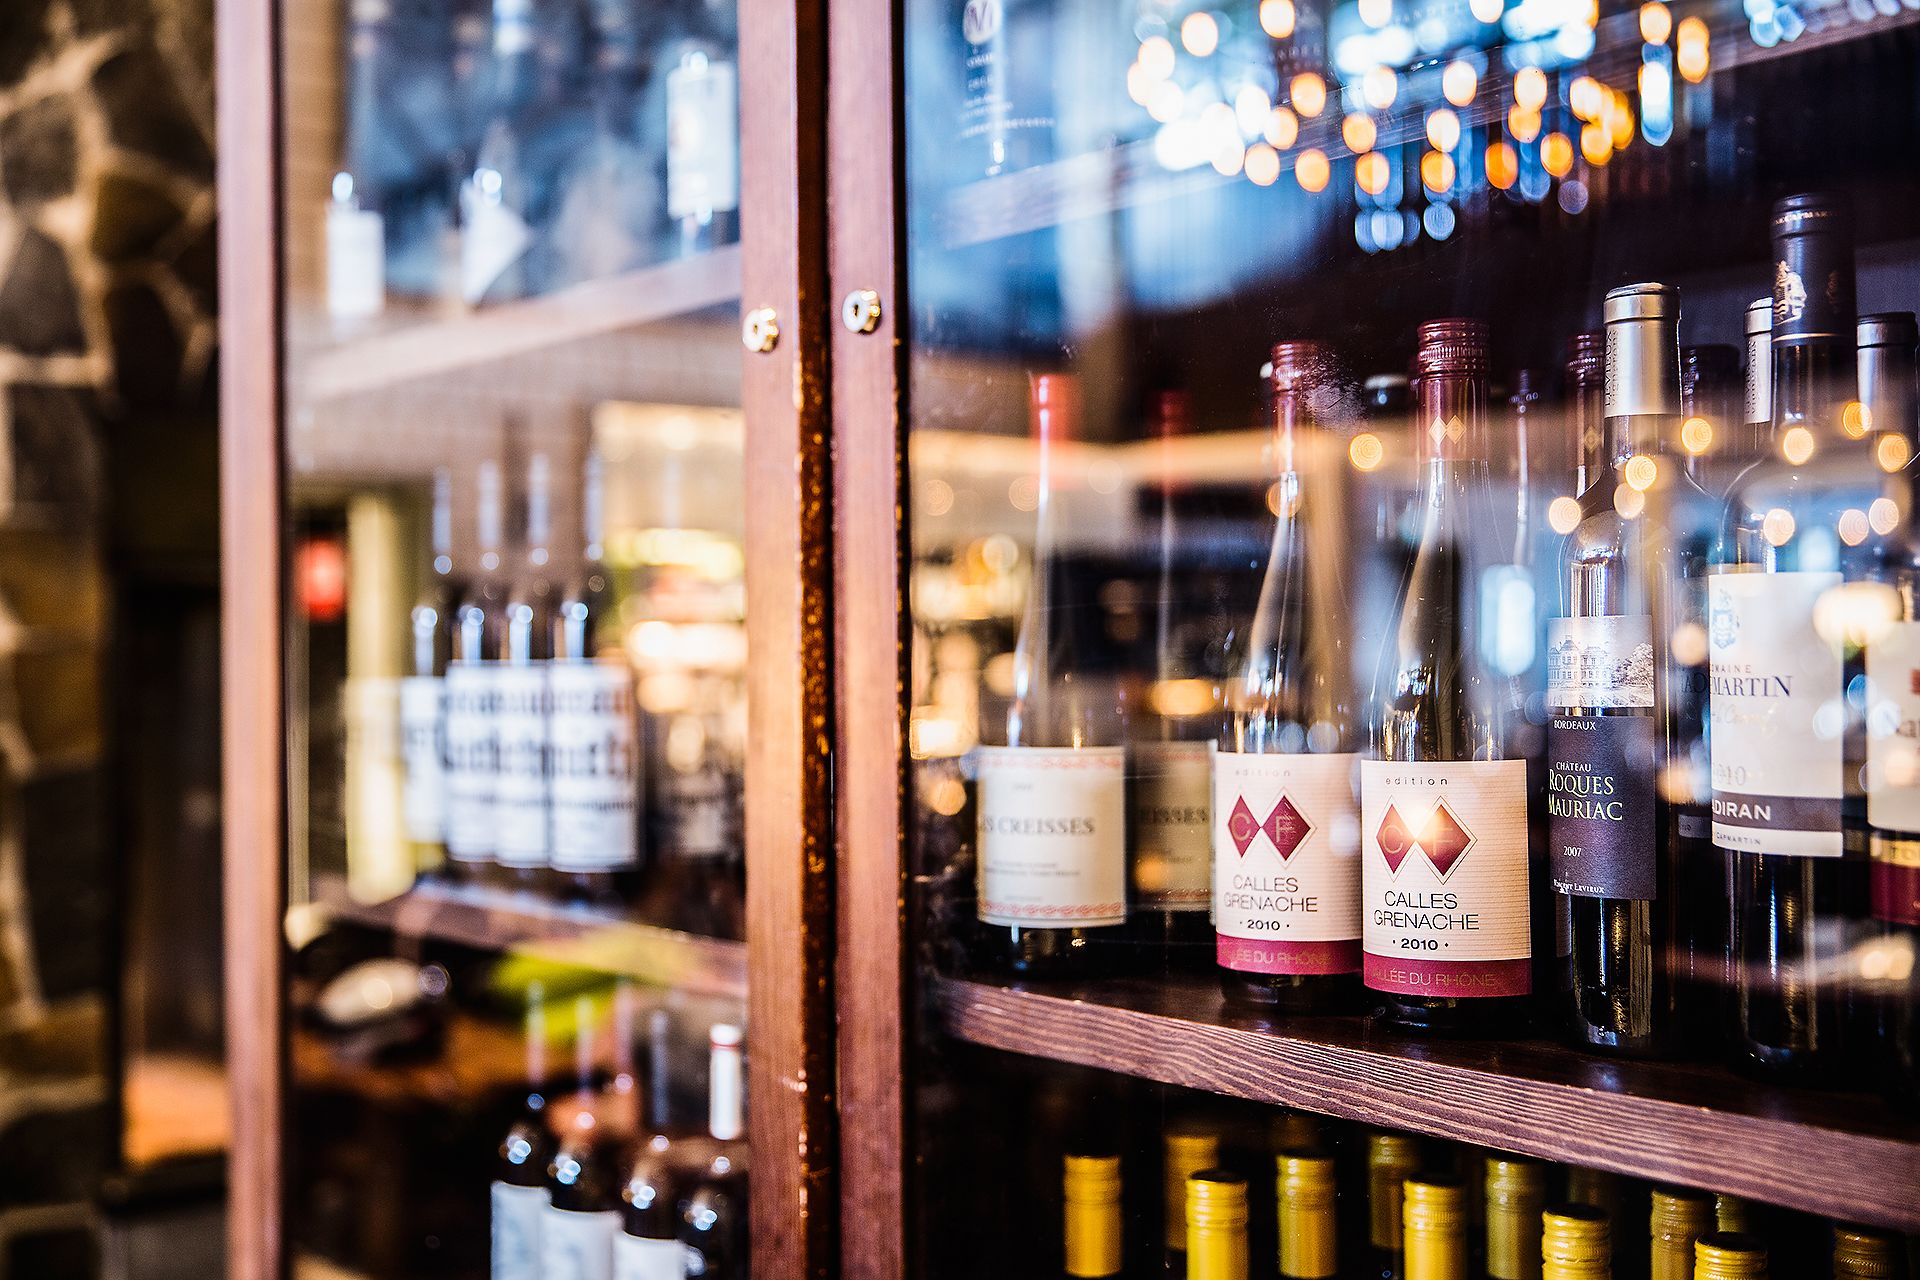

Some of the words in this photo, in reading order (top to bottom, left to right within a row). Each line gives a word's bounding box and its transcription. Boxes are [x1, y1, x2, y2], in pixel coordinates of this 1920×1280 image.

[1553, 719, 1597, 731] BORDEAUX
[1555, 760, 1592, 772] CHÂTEAU
[1385, 776, 1448, 786] edition
[1549, 768, 1614, 798] ROQUES
[1548, 793, 1624, 821] MAURIAC
[997, 815, 1095, 835] CREISSES
[1563, 845, 1582, 857] 2007
[1232, 874, 1300, 893] CALLES
[1223, 892, 1319, 913] GRENACHE
[1384, 890, 1458, 909] CALLES
[1246, 919, 1281, 931] 2010
[1374, 909, 1480, 930] GRENACHE
[1400, 937, 1439, 951] 2010
[1253, 950, 1275, 964] DU
[1409, 971, 1432, 986] DU
[1435, 970, 1498, 987] RHÔNE
